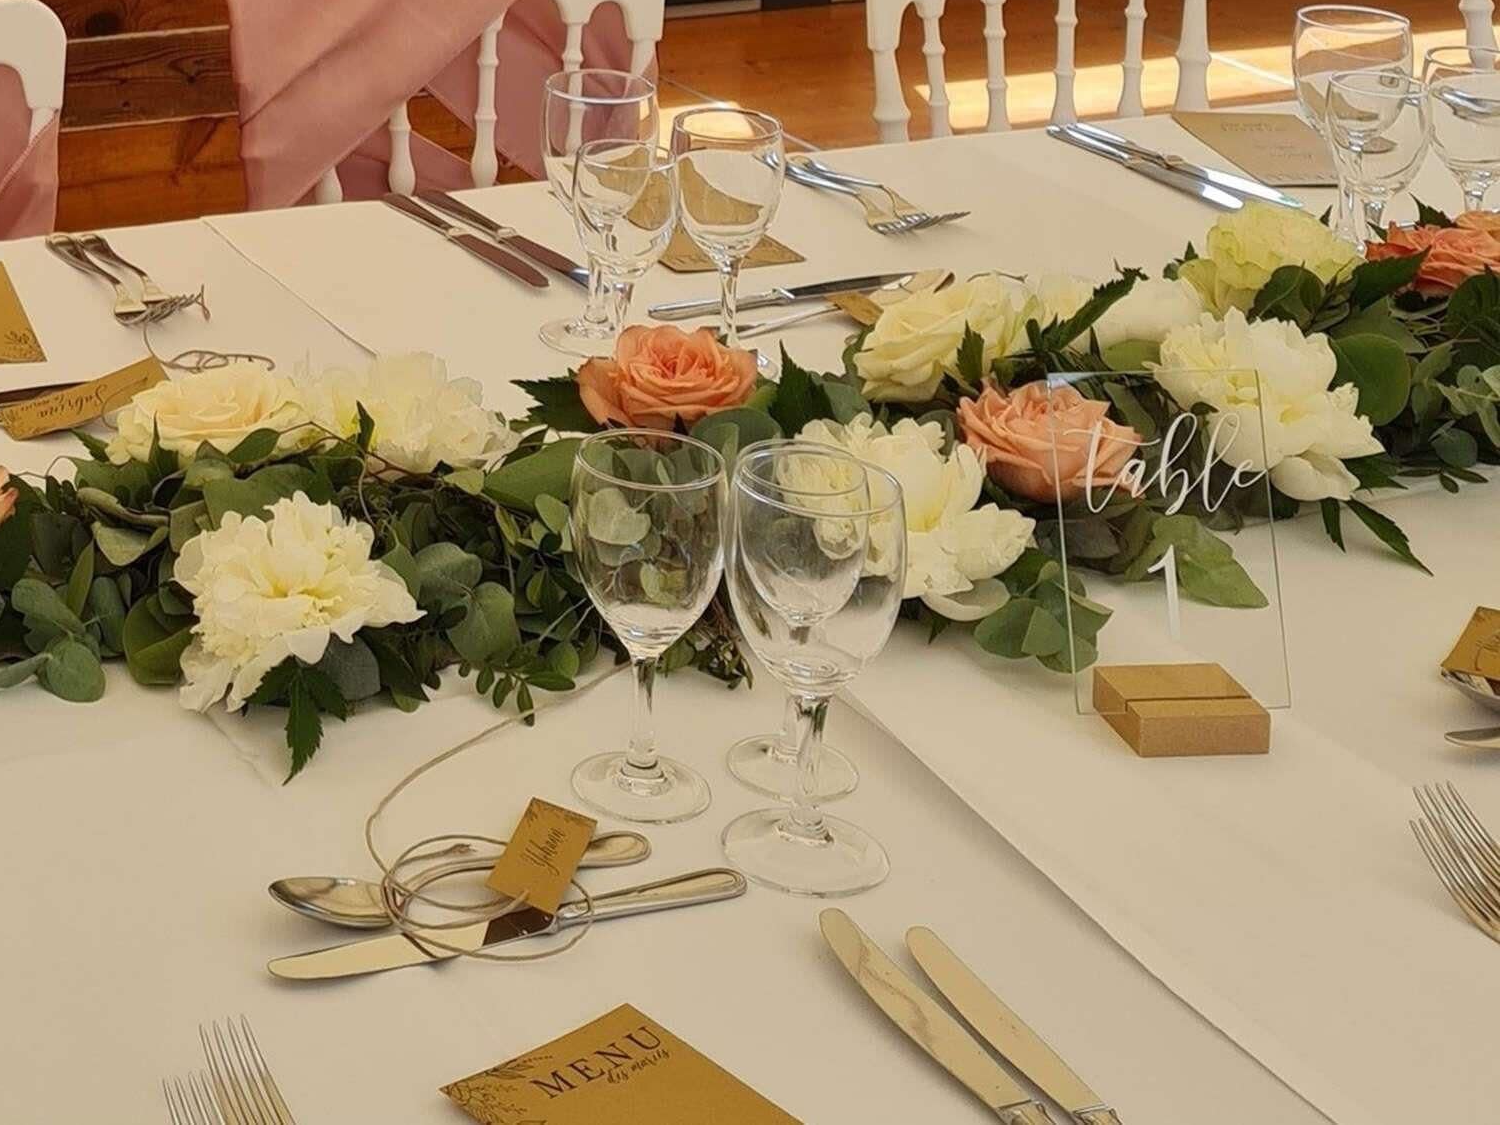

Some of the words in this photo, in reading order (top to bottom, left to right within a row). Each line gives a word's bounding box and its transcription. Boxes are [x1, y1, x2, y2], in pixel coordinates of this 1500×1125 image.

[38, 384, 109, 419] Sabrina
[1061, 412, 1268, 516] table
[1147, 543, 1181, 642] 1
[529, 1025, 664, 1100] MENU
